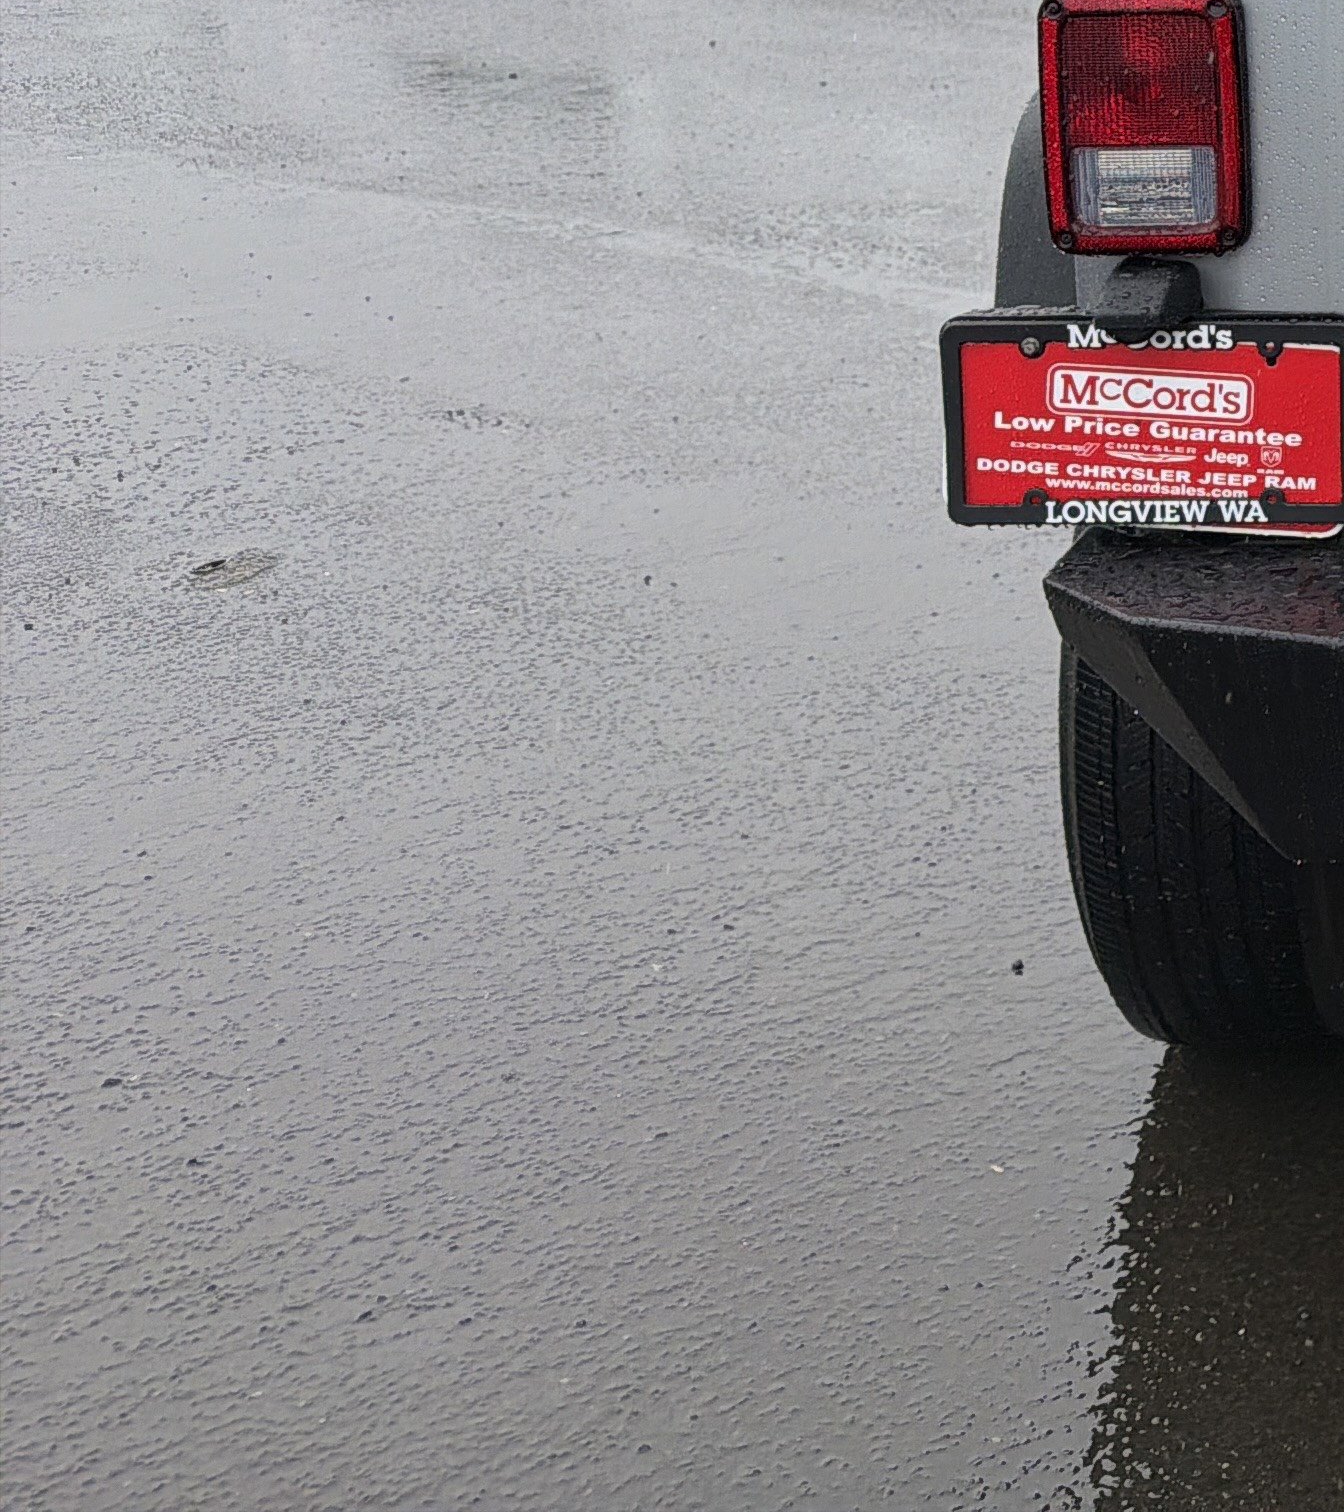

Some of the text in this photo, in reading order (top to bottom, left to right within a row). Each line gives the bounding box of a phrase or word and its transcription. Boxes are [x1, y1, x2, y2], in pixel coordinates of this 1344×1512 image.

[1060, 373, 1240, 415] McCord's
[993, 411, 1303, 447] Low Price Guarantee
[1104, 441, 1197, 455] CHRYSLER
[1204, 447, 1249, 468] Jeep
[976, 457, 1317, 491] DODGE CHRYSLER JEEP RAM
[1045, 477, 1249, 498] www.mccordsales.com
[1045, 500, 1269, 524] LONGVIEW WA
